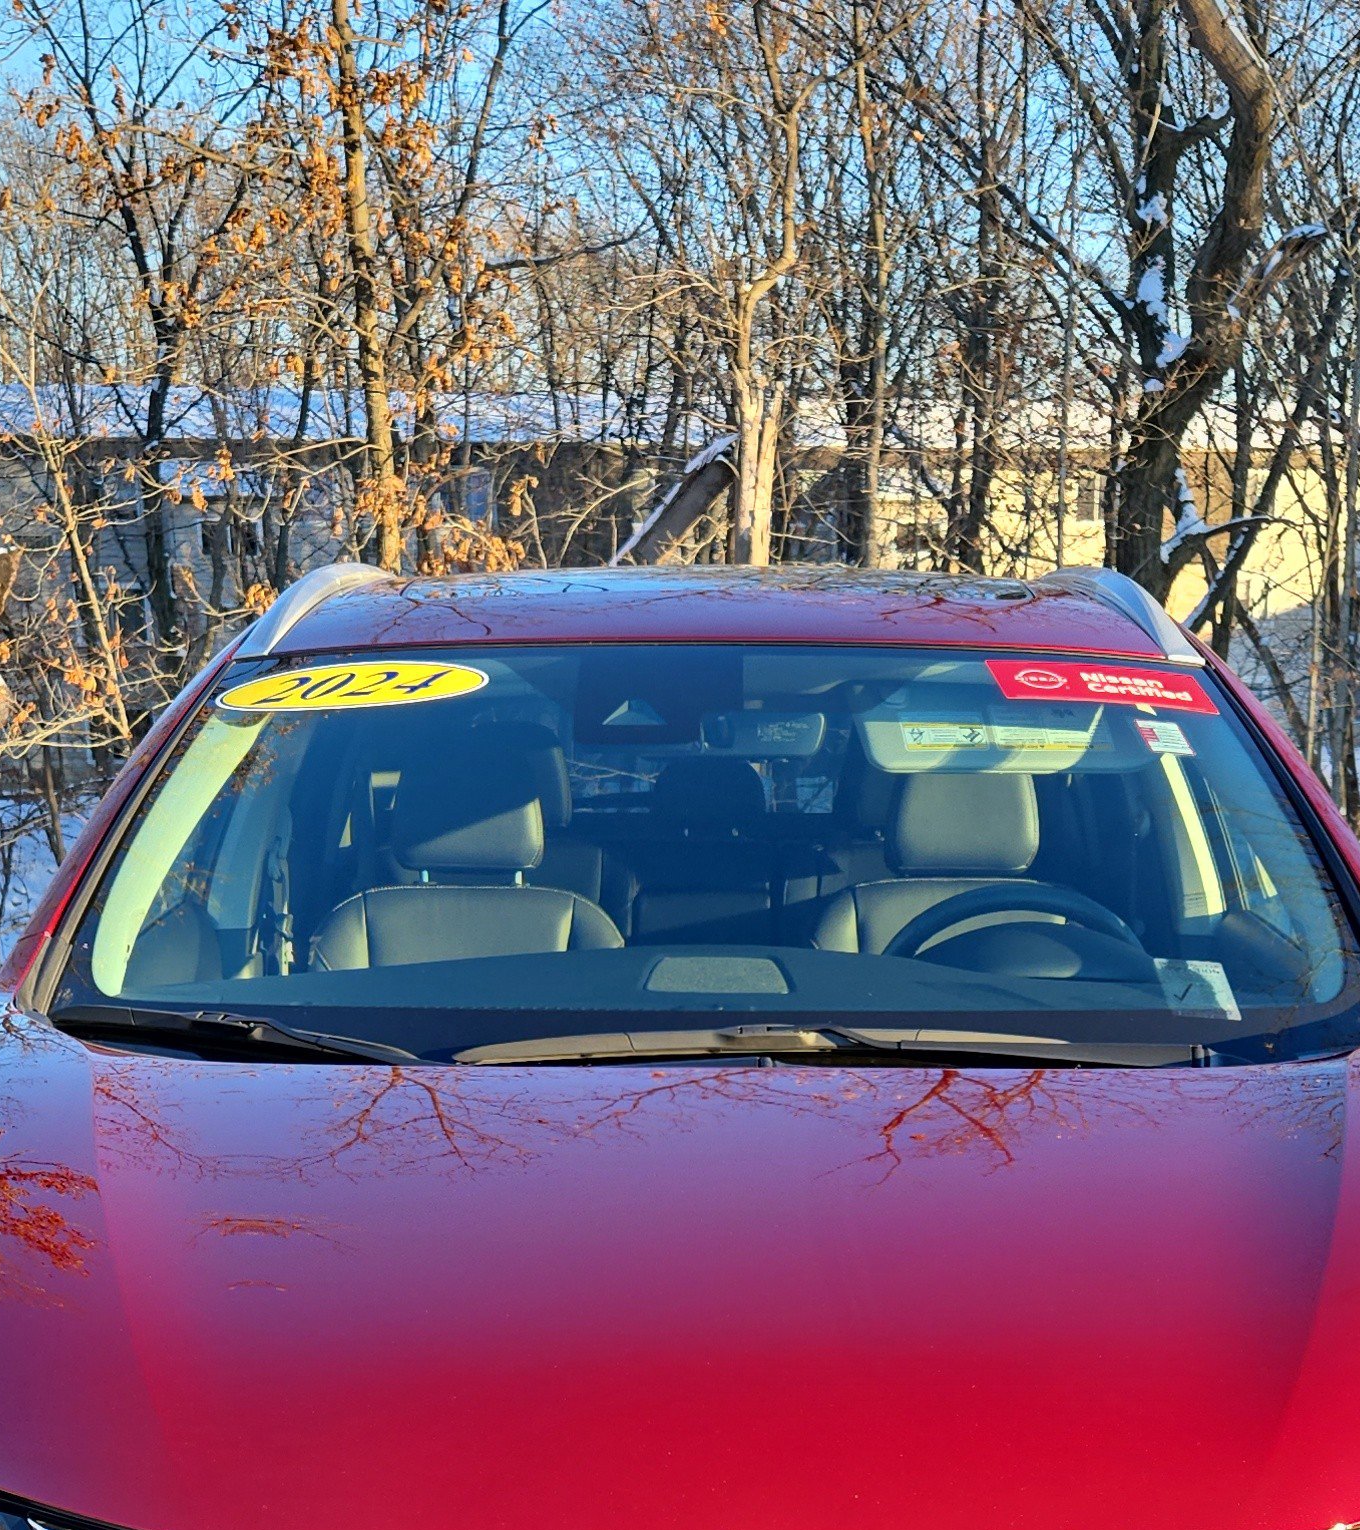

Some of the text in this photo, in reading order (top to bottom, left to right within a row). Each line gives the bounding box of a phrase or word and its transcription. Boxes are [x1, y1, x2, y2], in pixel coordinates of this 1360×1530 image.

[250, 669, 454, 706] 2024
[1080, 672, 1164, 689] Nissan
[1087, 682, 1193, 702] Certified
